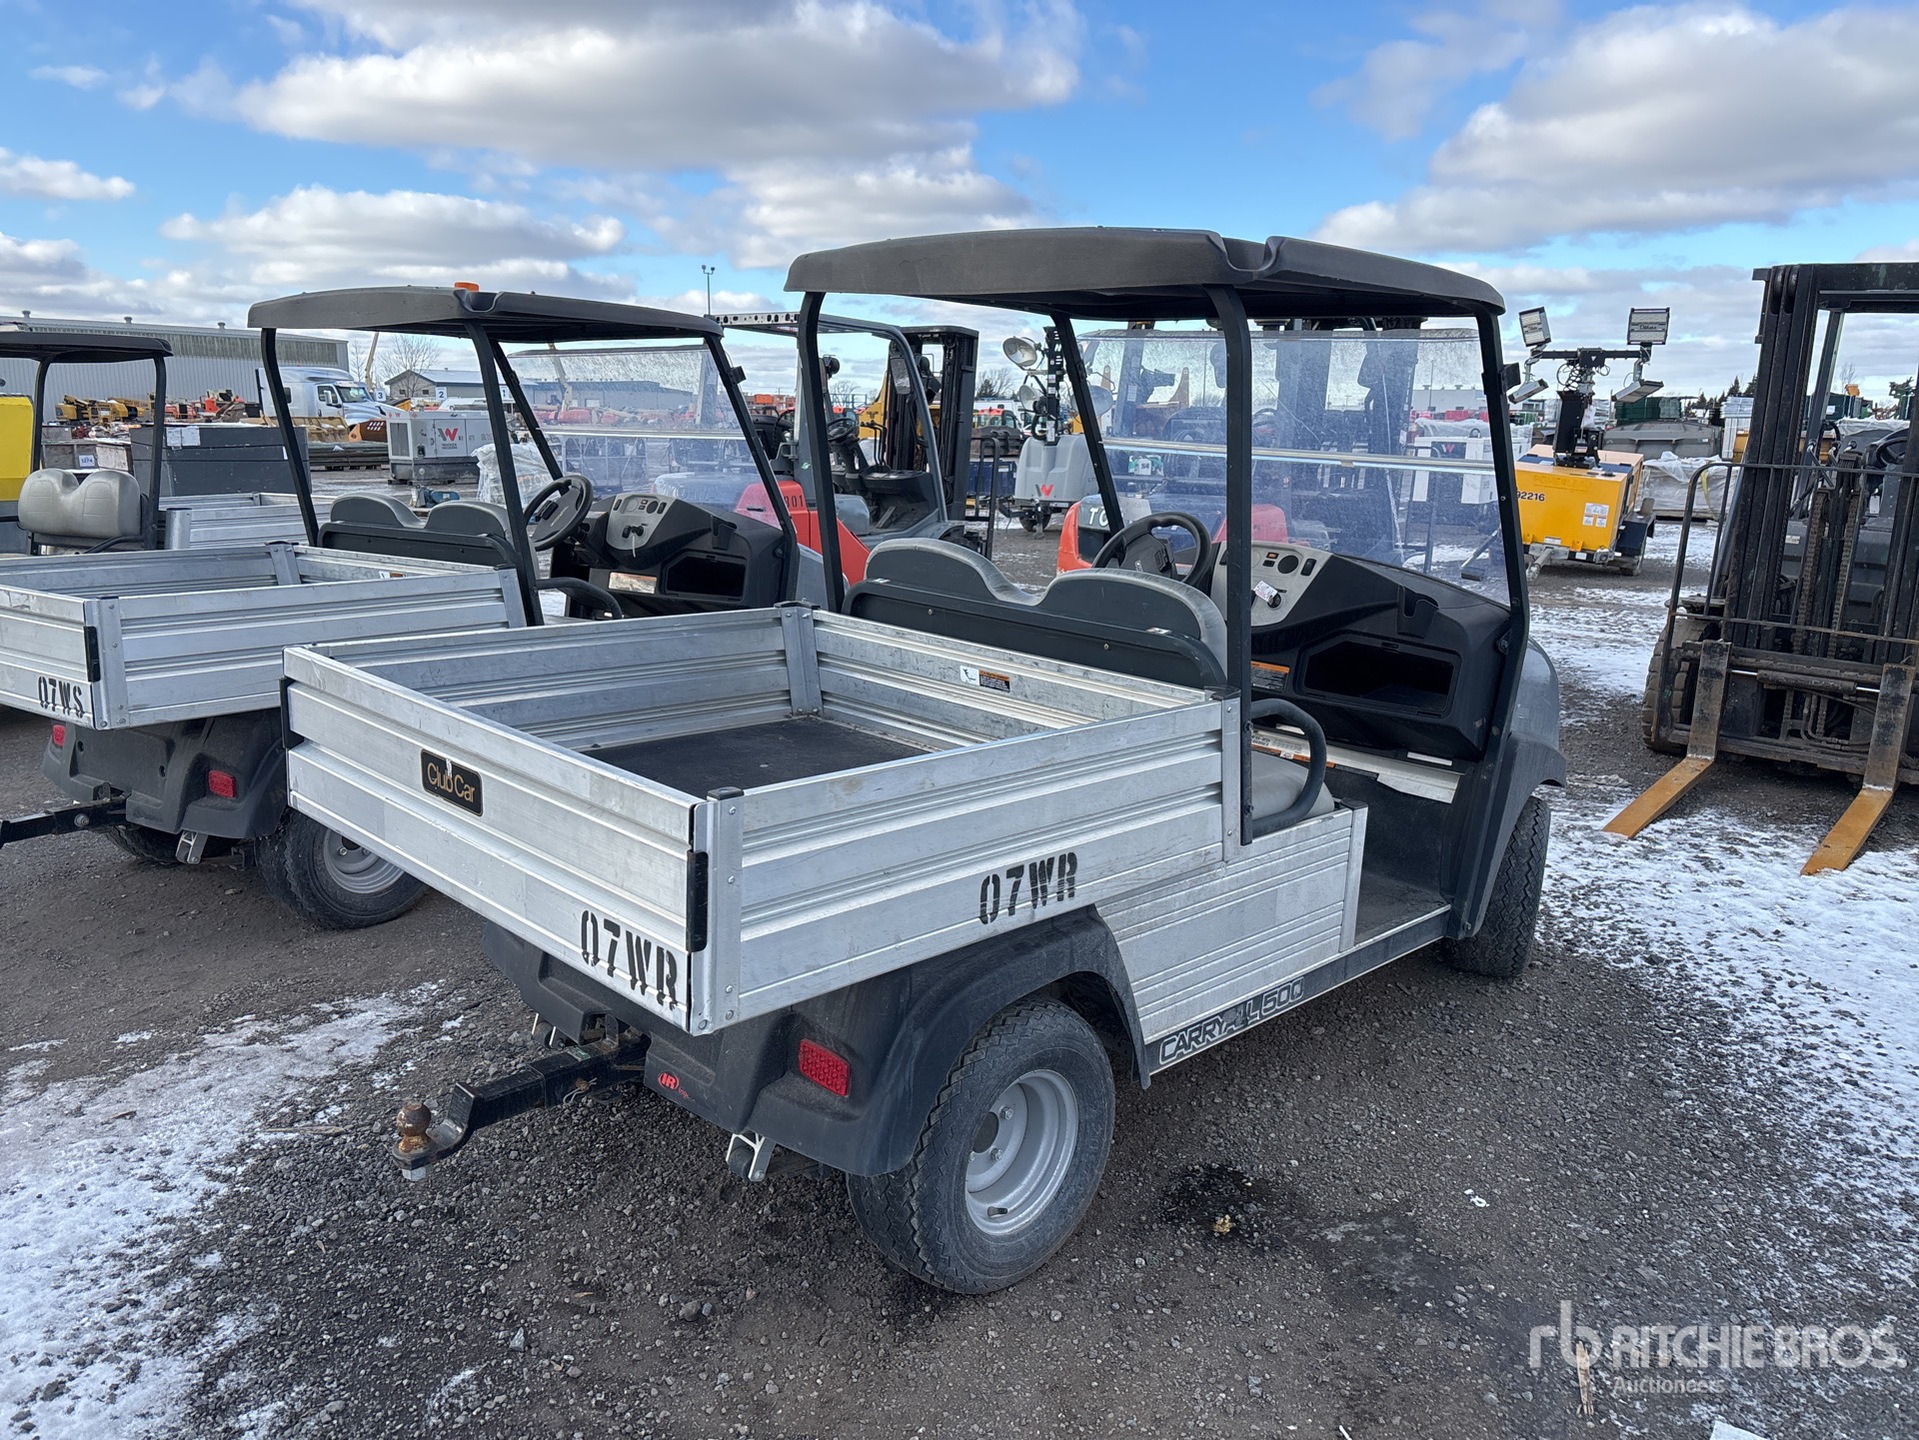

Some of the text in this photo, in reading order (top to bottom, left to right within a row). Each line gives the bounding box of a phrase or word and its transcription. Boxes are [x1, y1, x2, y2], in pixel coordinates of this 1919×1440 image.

[38, 676, 84, 719] 07WS
[427, 762, 476, 803] Club Car
[980, 852, 1077, 925] 07WR
[581, 910, 678, 1011] 07WR
[1261, 976, 1304, 1016] 500
